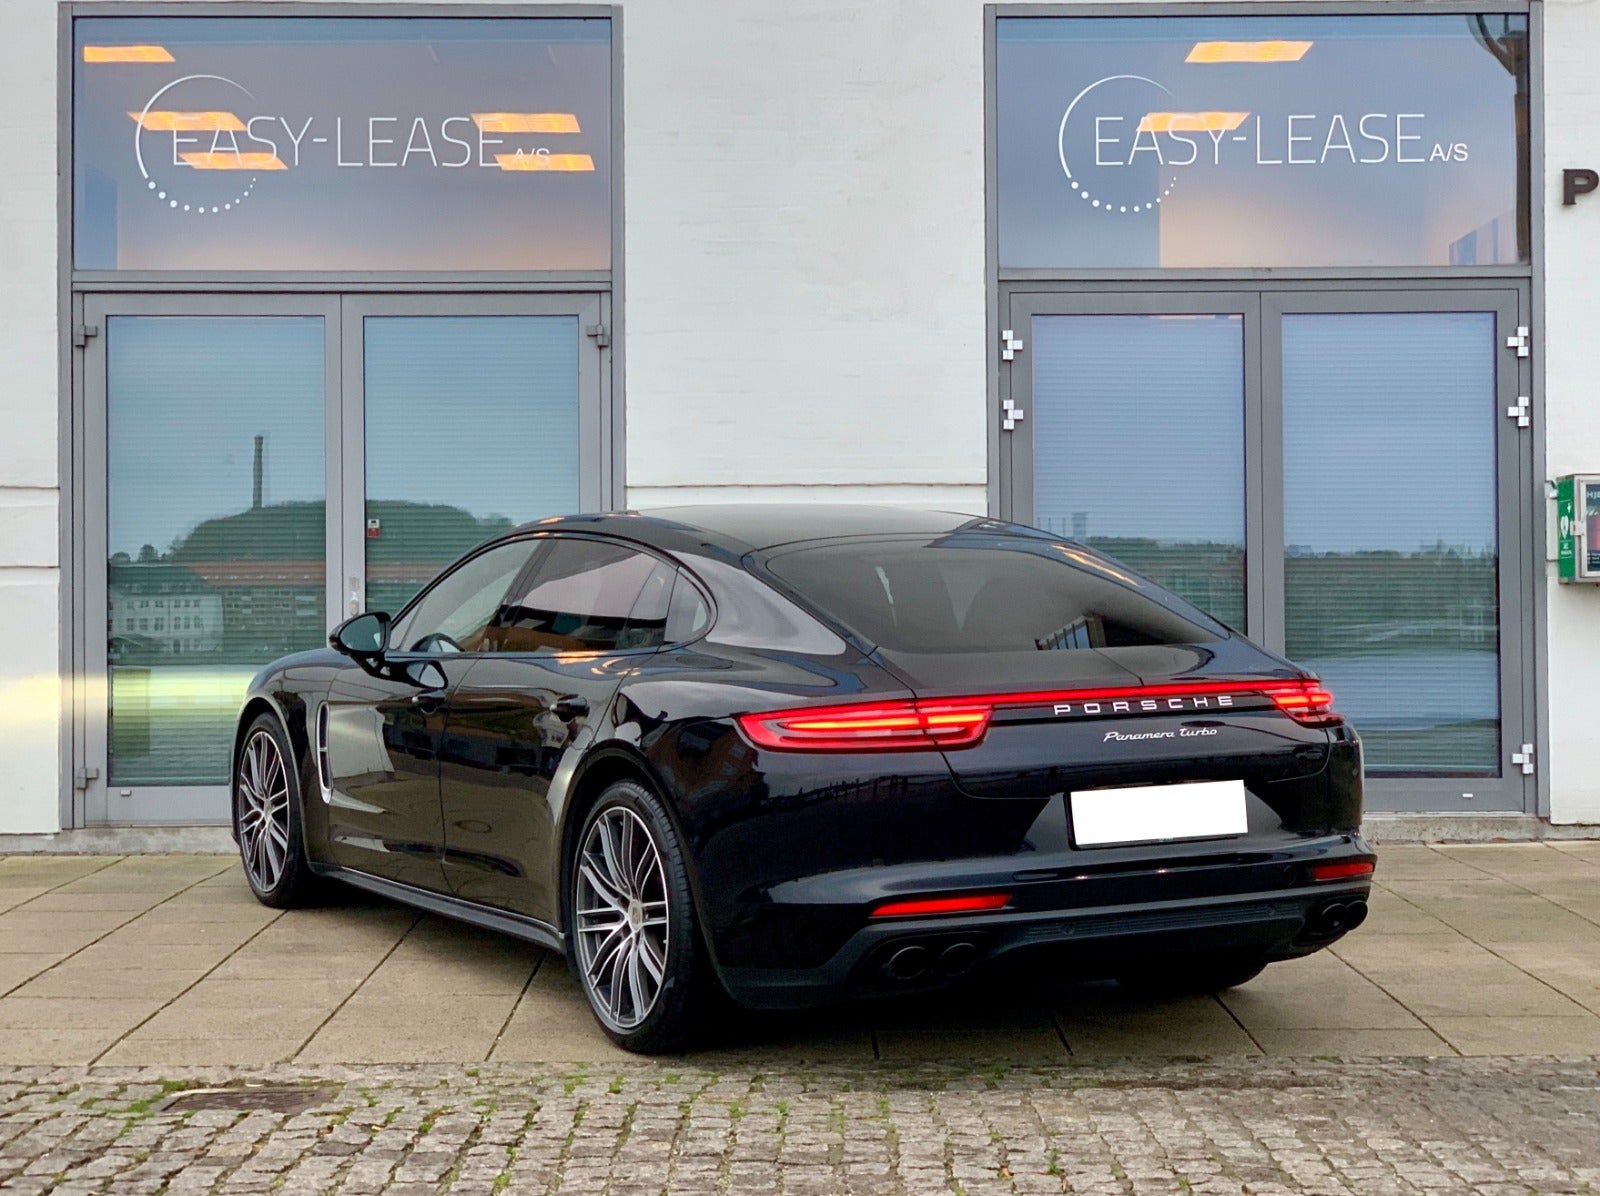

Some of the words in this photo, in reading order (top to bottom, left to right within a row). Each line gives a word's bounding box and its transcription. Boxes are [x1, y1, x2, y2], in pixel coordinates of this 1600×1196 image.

[171, 115, 504, 168] EASY-LEASE
[1095, 113, 1426, 165] EASY-LEASE
[1429, 142, 1470, 162] A/S
[1562, 168, 1599, 206] P
[1054, 695, 1233, 715] PORSCHE
[1103, 731, 1176, 742] Panamera
